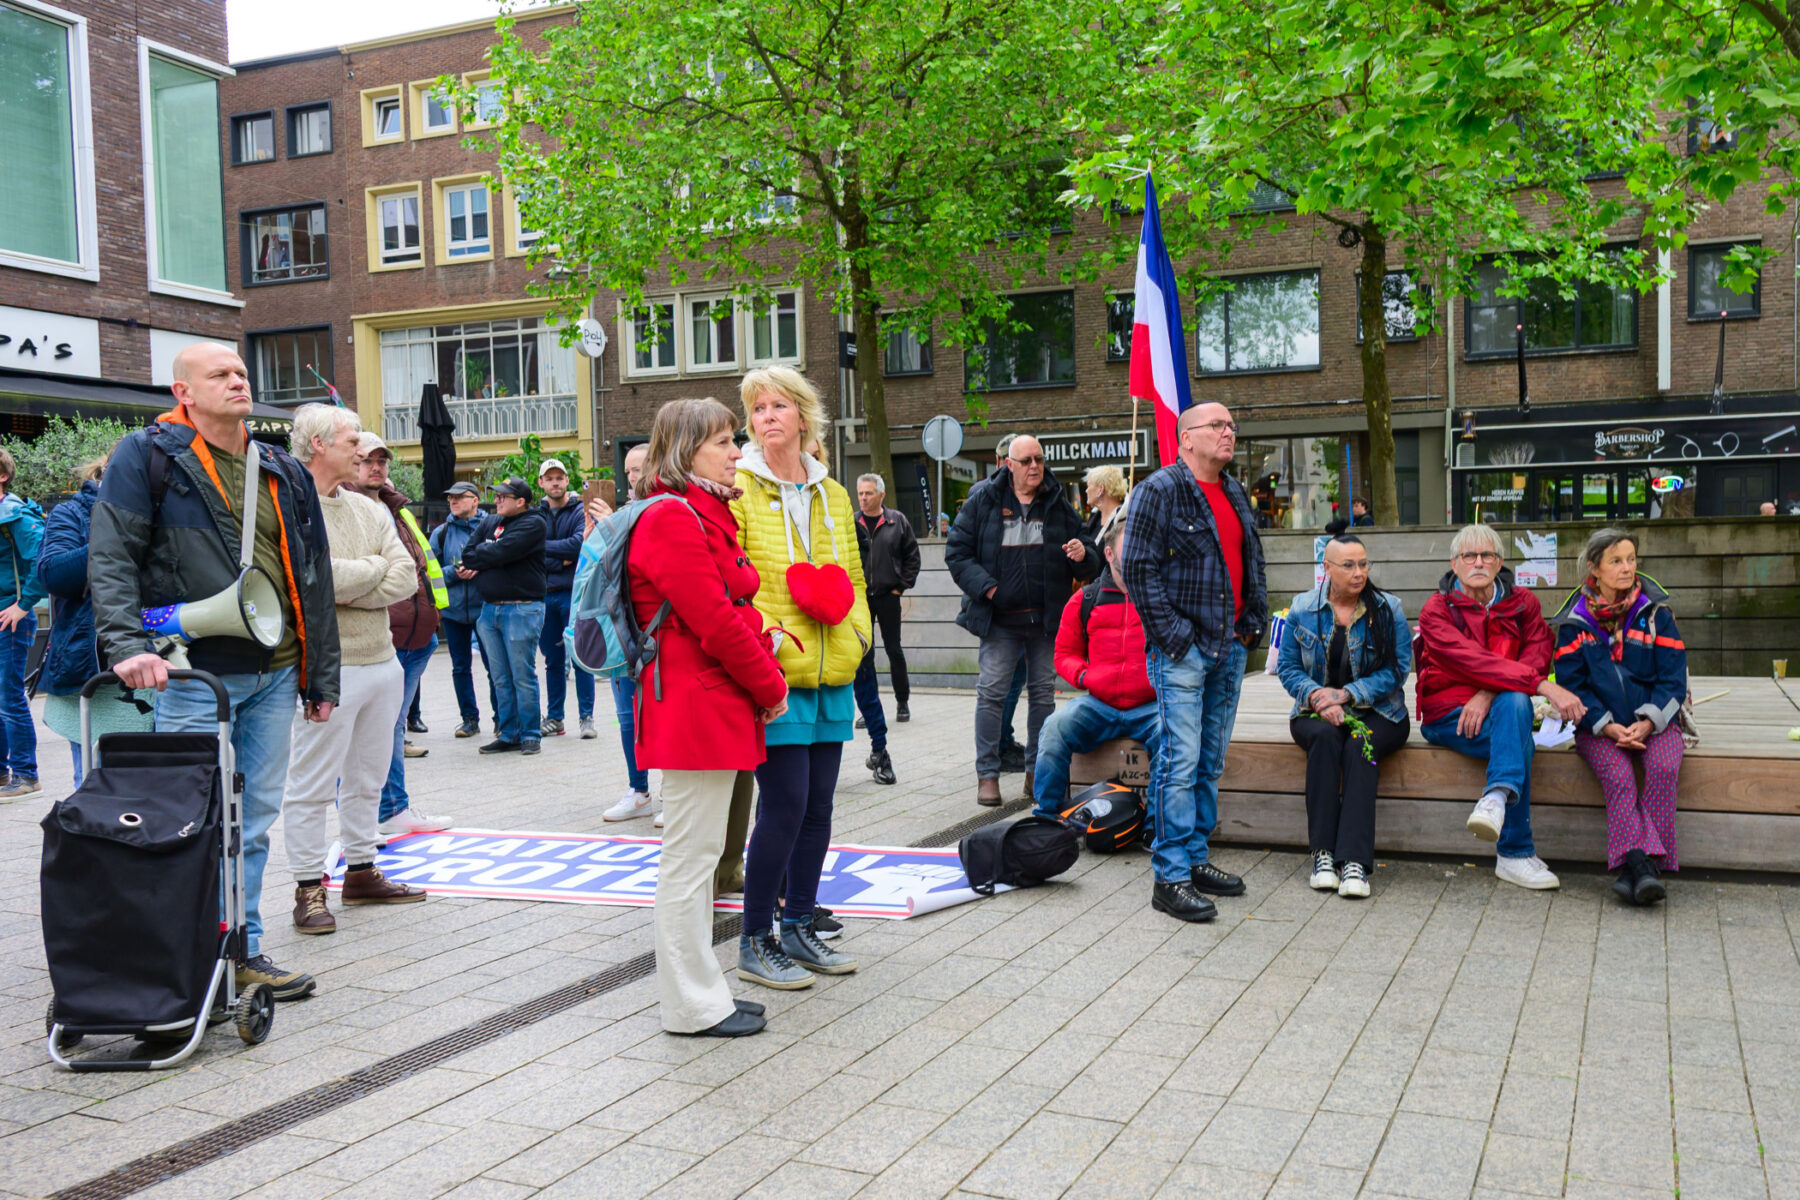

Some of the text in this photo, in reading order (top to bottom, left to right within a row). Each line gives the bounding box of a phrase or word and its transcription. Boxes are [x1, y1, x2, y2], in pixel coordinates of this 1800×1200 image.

[246, 420, 293, 433] ZAPP
[1044, 440, 1139, 461] HILCKMANN
[1651, 477, 1684, 491] OPEN
